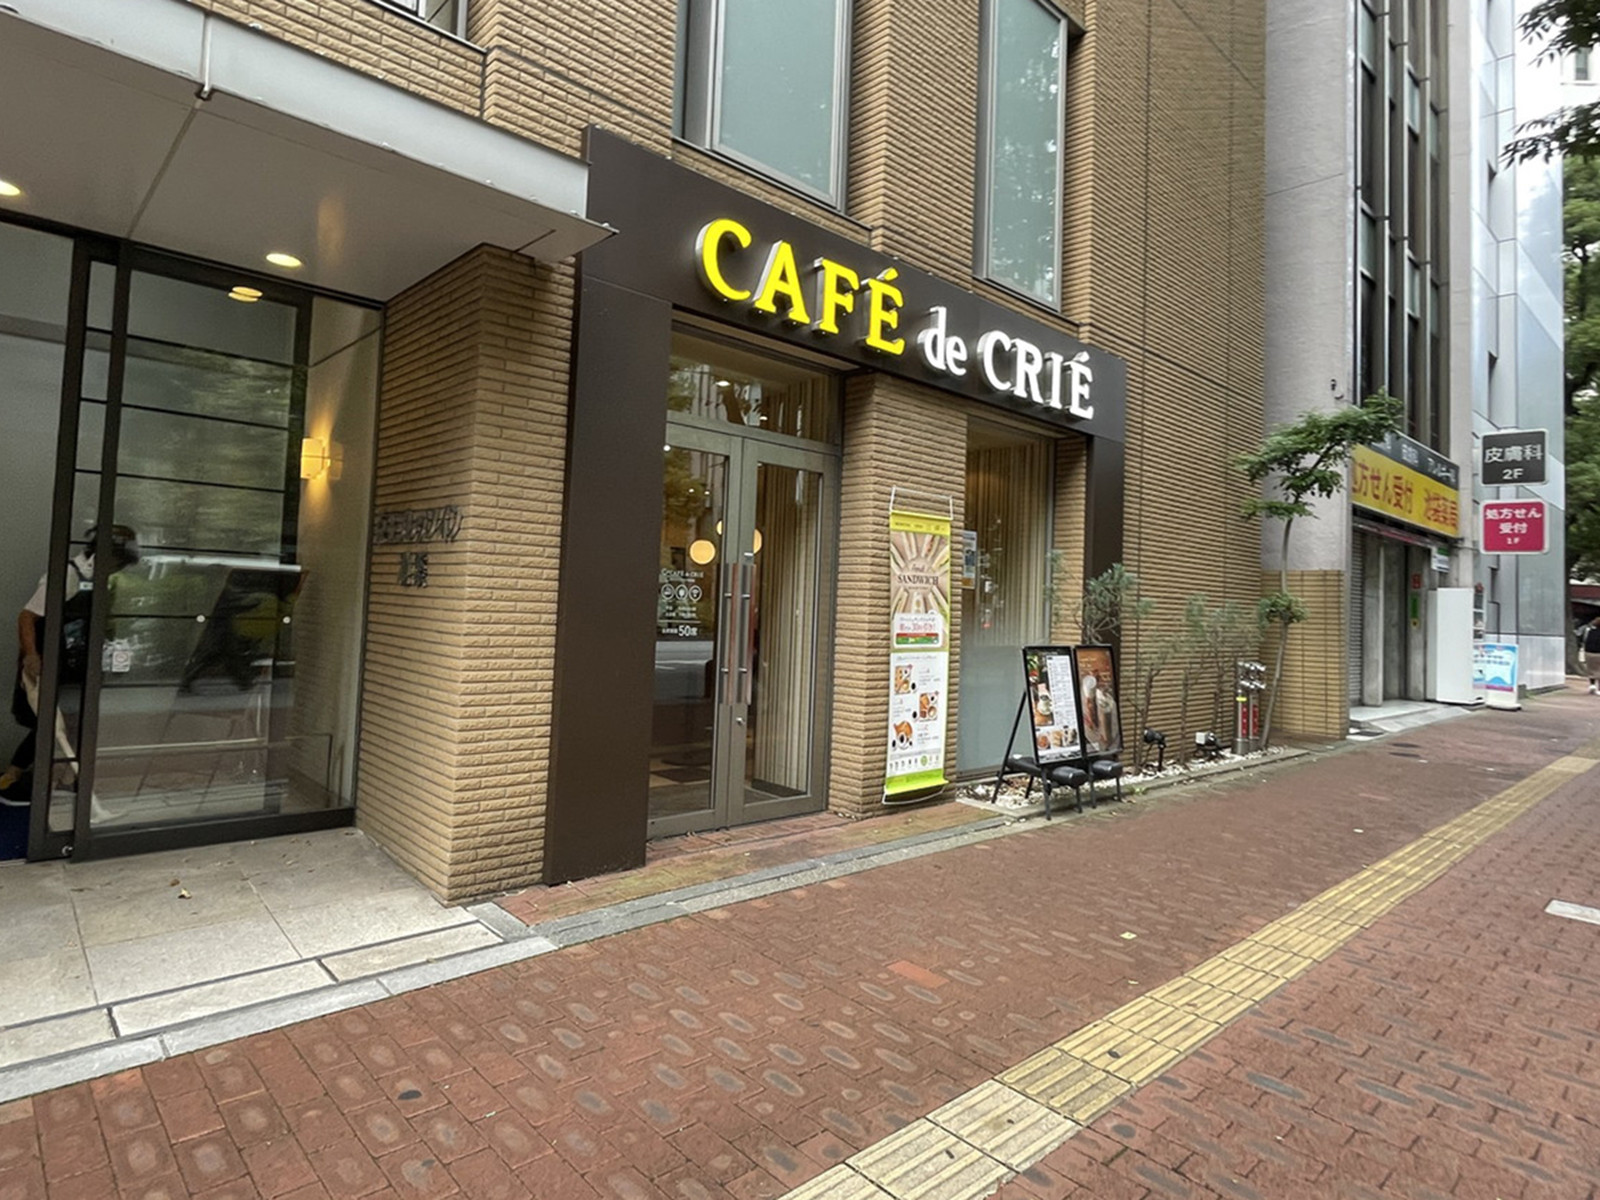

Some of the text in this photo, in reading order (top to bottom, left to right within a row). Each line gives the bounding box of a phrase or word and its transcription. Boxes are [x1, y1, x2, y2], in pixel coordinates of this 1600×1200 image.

[697, 217, 1094, 420] CAFÉ de CRIÉ
[1484, 444, 1544, 463] 皮膚科
[1502, 468, 1524, 480] 2F
[1485, 508, 1543, 520] 処方せん
[1499, 522, 1528, 534] 受付
[1506, 536, 1521, 545] 1F
[897, 573, 940, 586] SANDWICH
